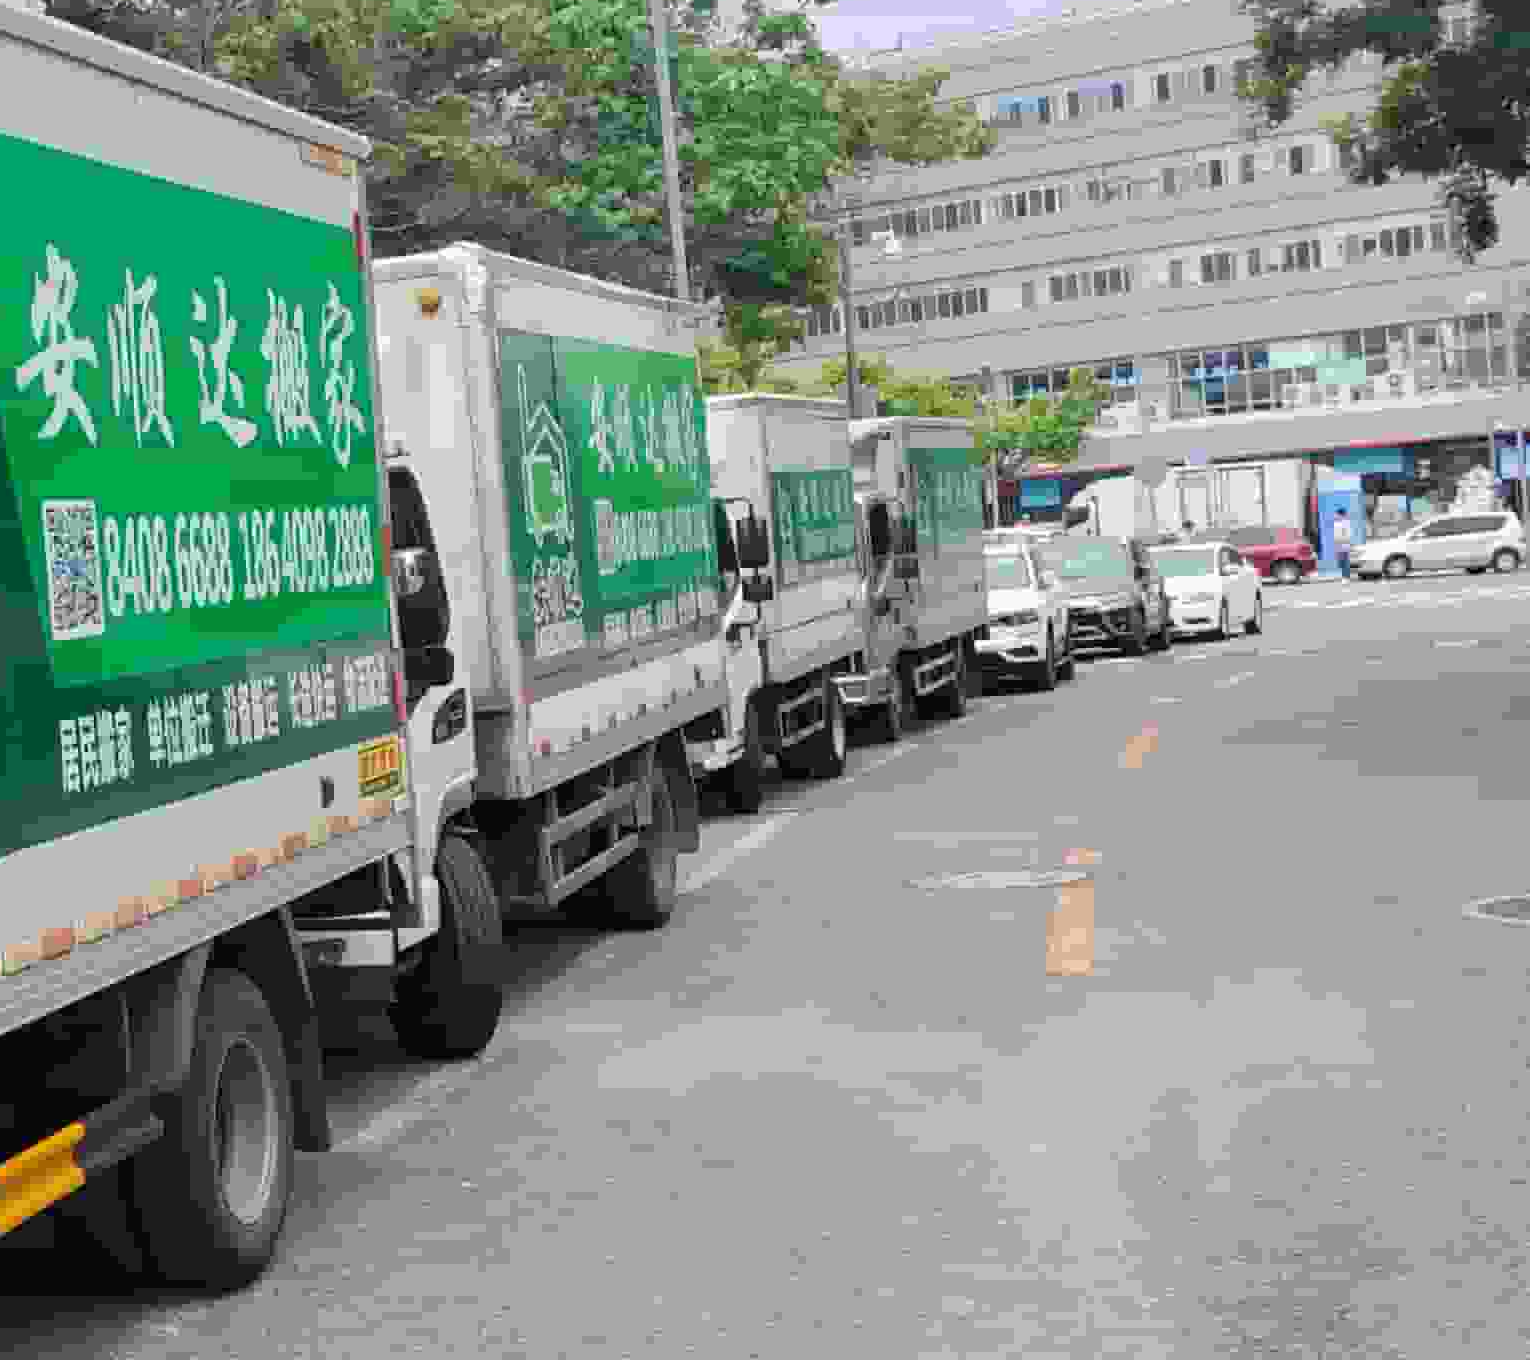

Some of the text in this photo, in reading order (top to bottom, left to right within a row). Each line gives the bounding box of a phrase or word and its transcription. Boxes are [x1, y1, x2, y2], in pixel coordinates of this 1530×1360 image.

[15, 240, 366, 472] 安顺达搬家
[103, 511, 173, 617] 8408
[173, 511, 233, 609] 6688
